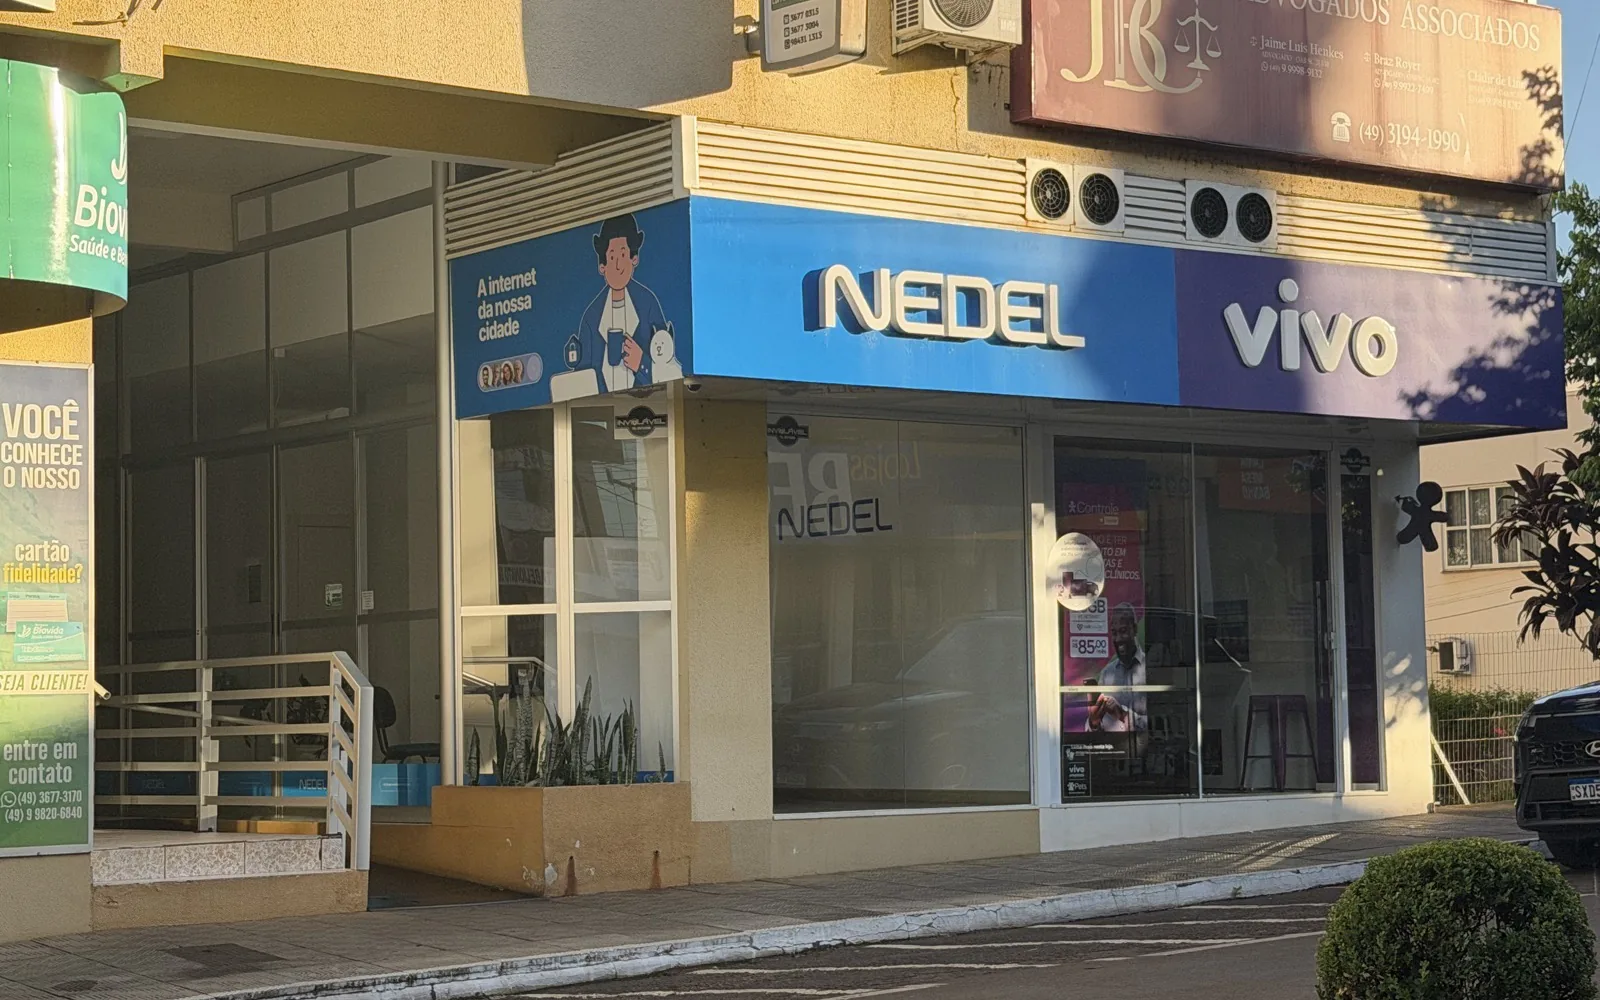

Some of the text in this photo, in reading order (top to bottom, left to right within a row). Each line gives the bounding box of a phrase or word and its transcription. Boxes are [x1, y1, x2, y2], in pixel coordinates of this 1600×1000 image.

[1401, 7, 1541, 51] ASSOCIADOS
[1260, 35, 1344, 59] Jaime Luis Henkes
[1359, 120, 1461, 153] (49) 3194-1990
[69, 234, 109, 259] Saúde
[110, 248, 117, 262] e
[477, 267, 537, 298] A internet
[478, 294, 532, 320] da nossa
[817, 264, 1086, 348] NEDEL
[478, 318, 520, 342] cidade
[1223, 278, 1398, 377] vivo
[1, 399, 80, 441] VOCÊ
[0, 441, 83, 466] CONHECE
[3, 466, 80, 490] O NOSSO
[778, 497, 893, 541] NEDEL
[1077, 501, 1119, 515] Controle
[15, 539, 70, 563] cartão
[2, 563, 84, 584] fidelidade?
[30, 674, 89, 691] CLIENTE!
[3, 739, 78, 761] entre em
[8, 762, 72, 785] contato
[1069, 764, 1085, 773] vivo
[18, 790, 82, 806] (49) 3677-3170
[5, 806, 82, 824] (49) 9 9820-6840
